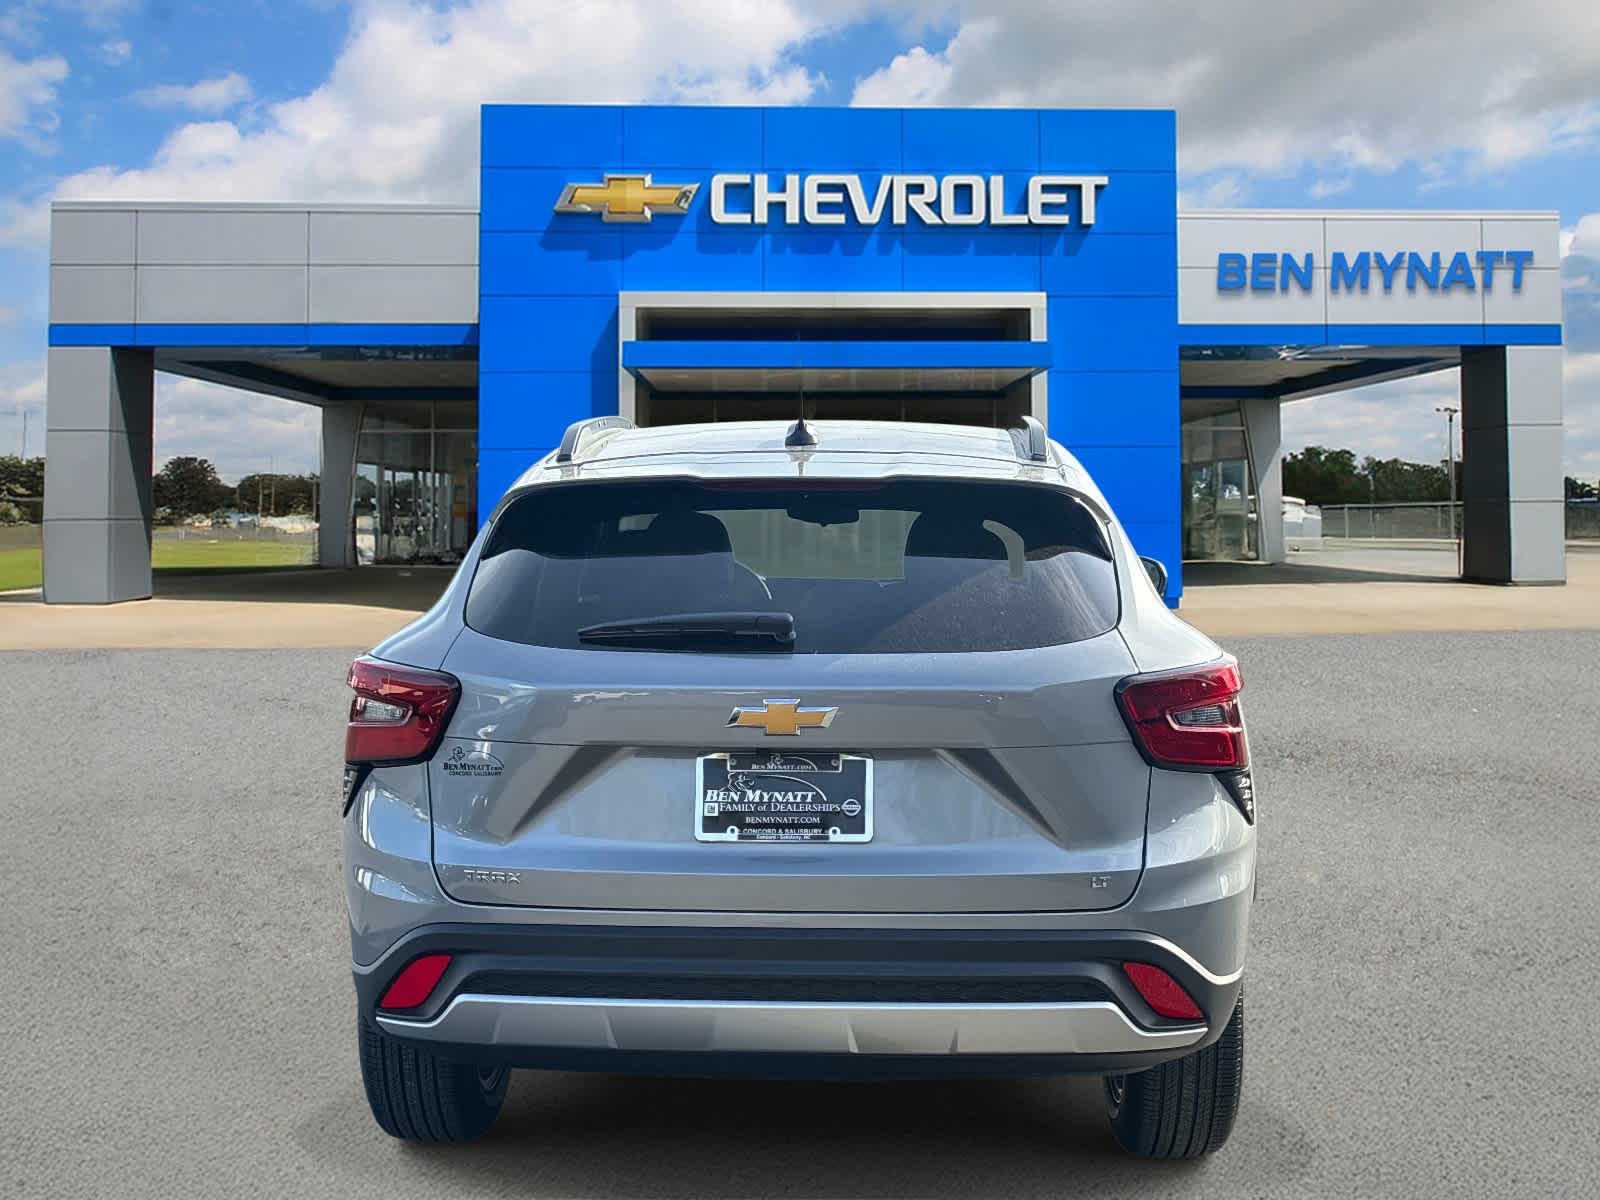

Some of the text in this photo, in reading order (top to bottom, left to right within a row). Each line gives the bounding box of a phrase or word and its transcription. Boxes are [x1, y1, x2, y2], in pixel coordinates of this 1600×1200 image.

[710, 173, 1110, 226] CHEVROLET
[1217, 250, 1534, 291] BEN MYNATT
[705, 790, 816, 803] BEN MYNATT
[719, 802, 841, 812] FAMILY of DEALERSHIPS
[745, 816, 820, 824] BENMYNATT.COM
[463, 869, 521, 884] TRAX
[1091, 876, 1111, 889] LT
